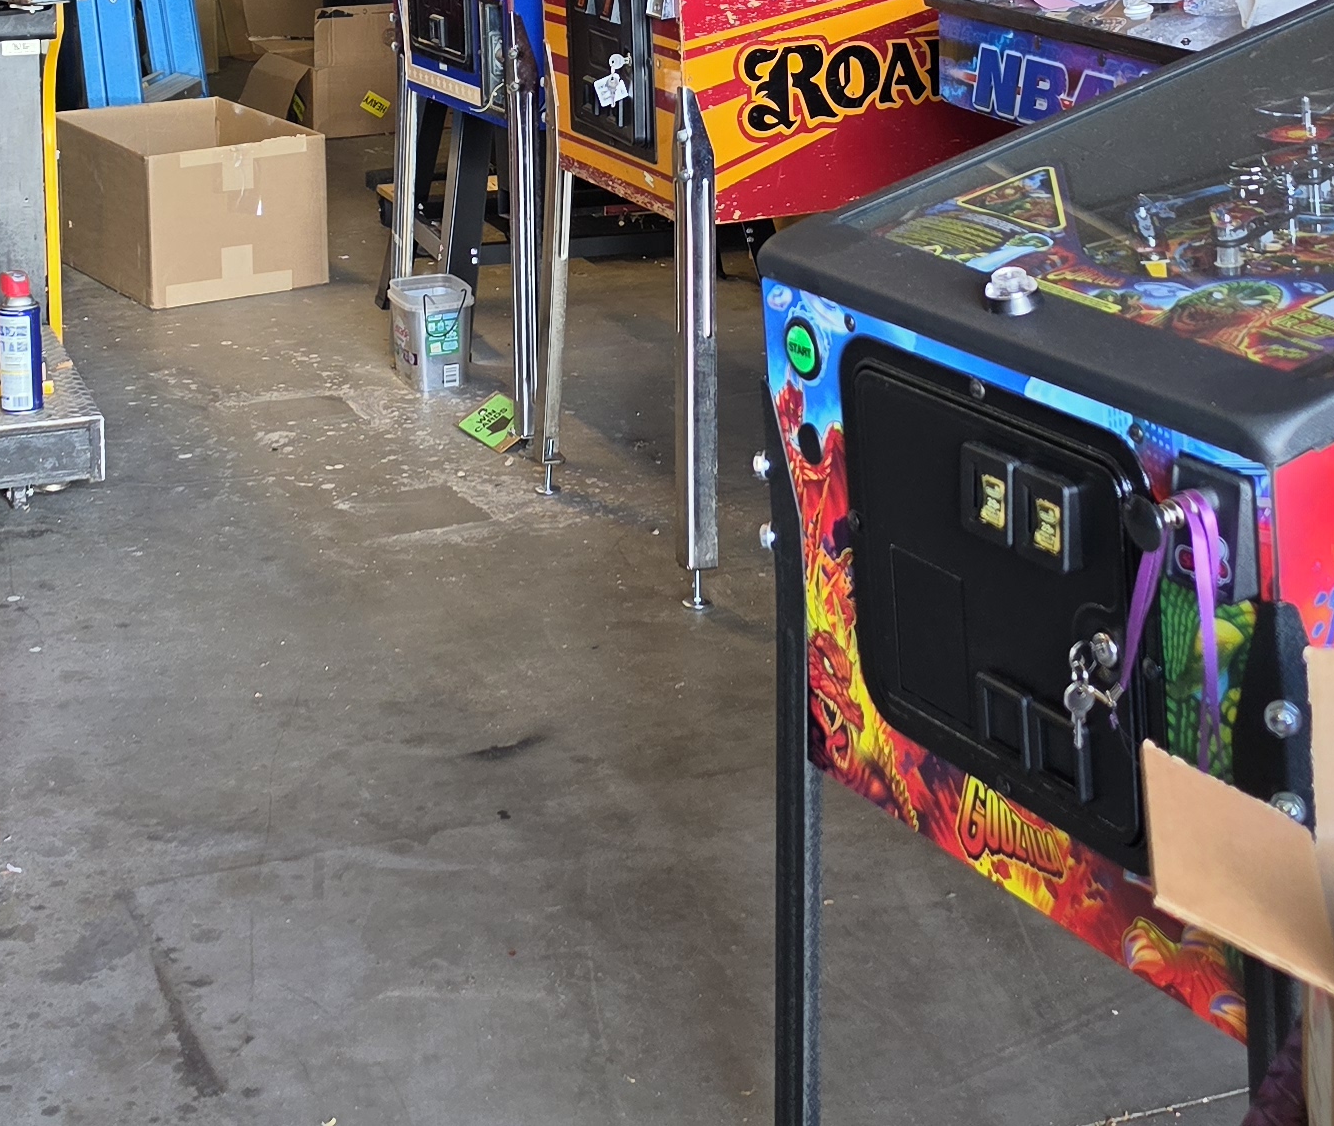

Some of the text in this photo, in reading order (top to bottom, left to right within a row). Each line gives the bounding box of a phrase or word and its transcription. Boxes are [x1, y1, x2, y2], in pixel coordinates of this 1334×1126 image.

[362, 96, 388, 114] HEAVY
[788, 341, 811, 359] START
[960, 775, 1065, 877] GODZILLA
